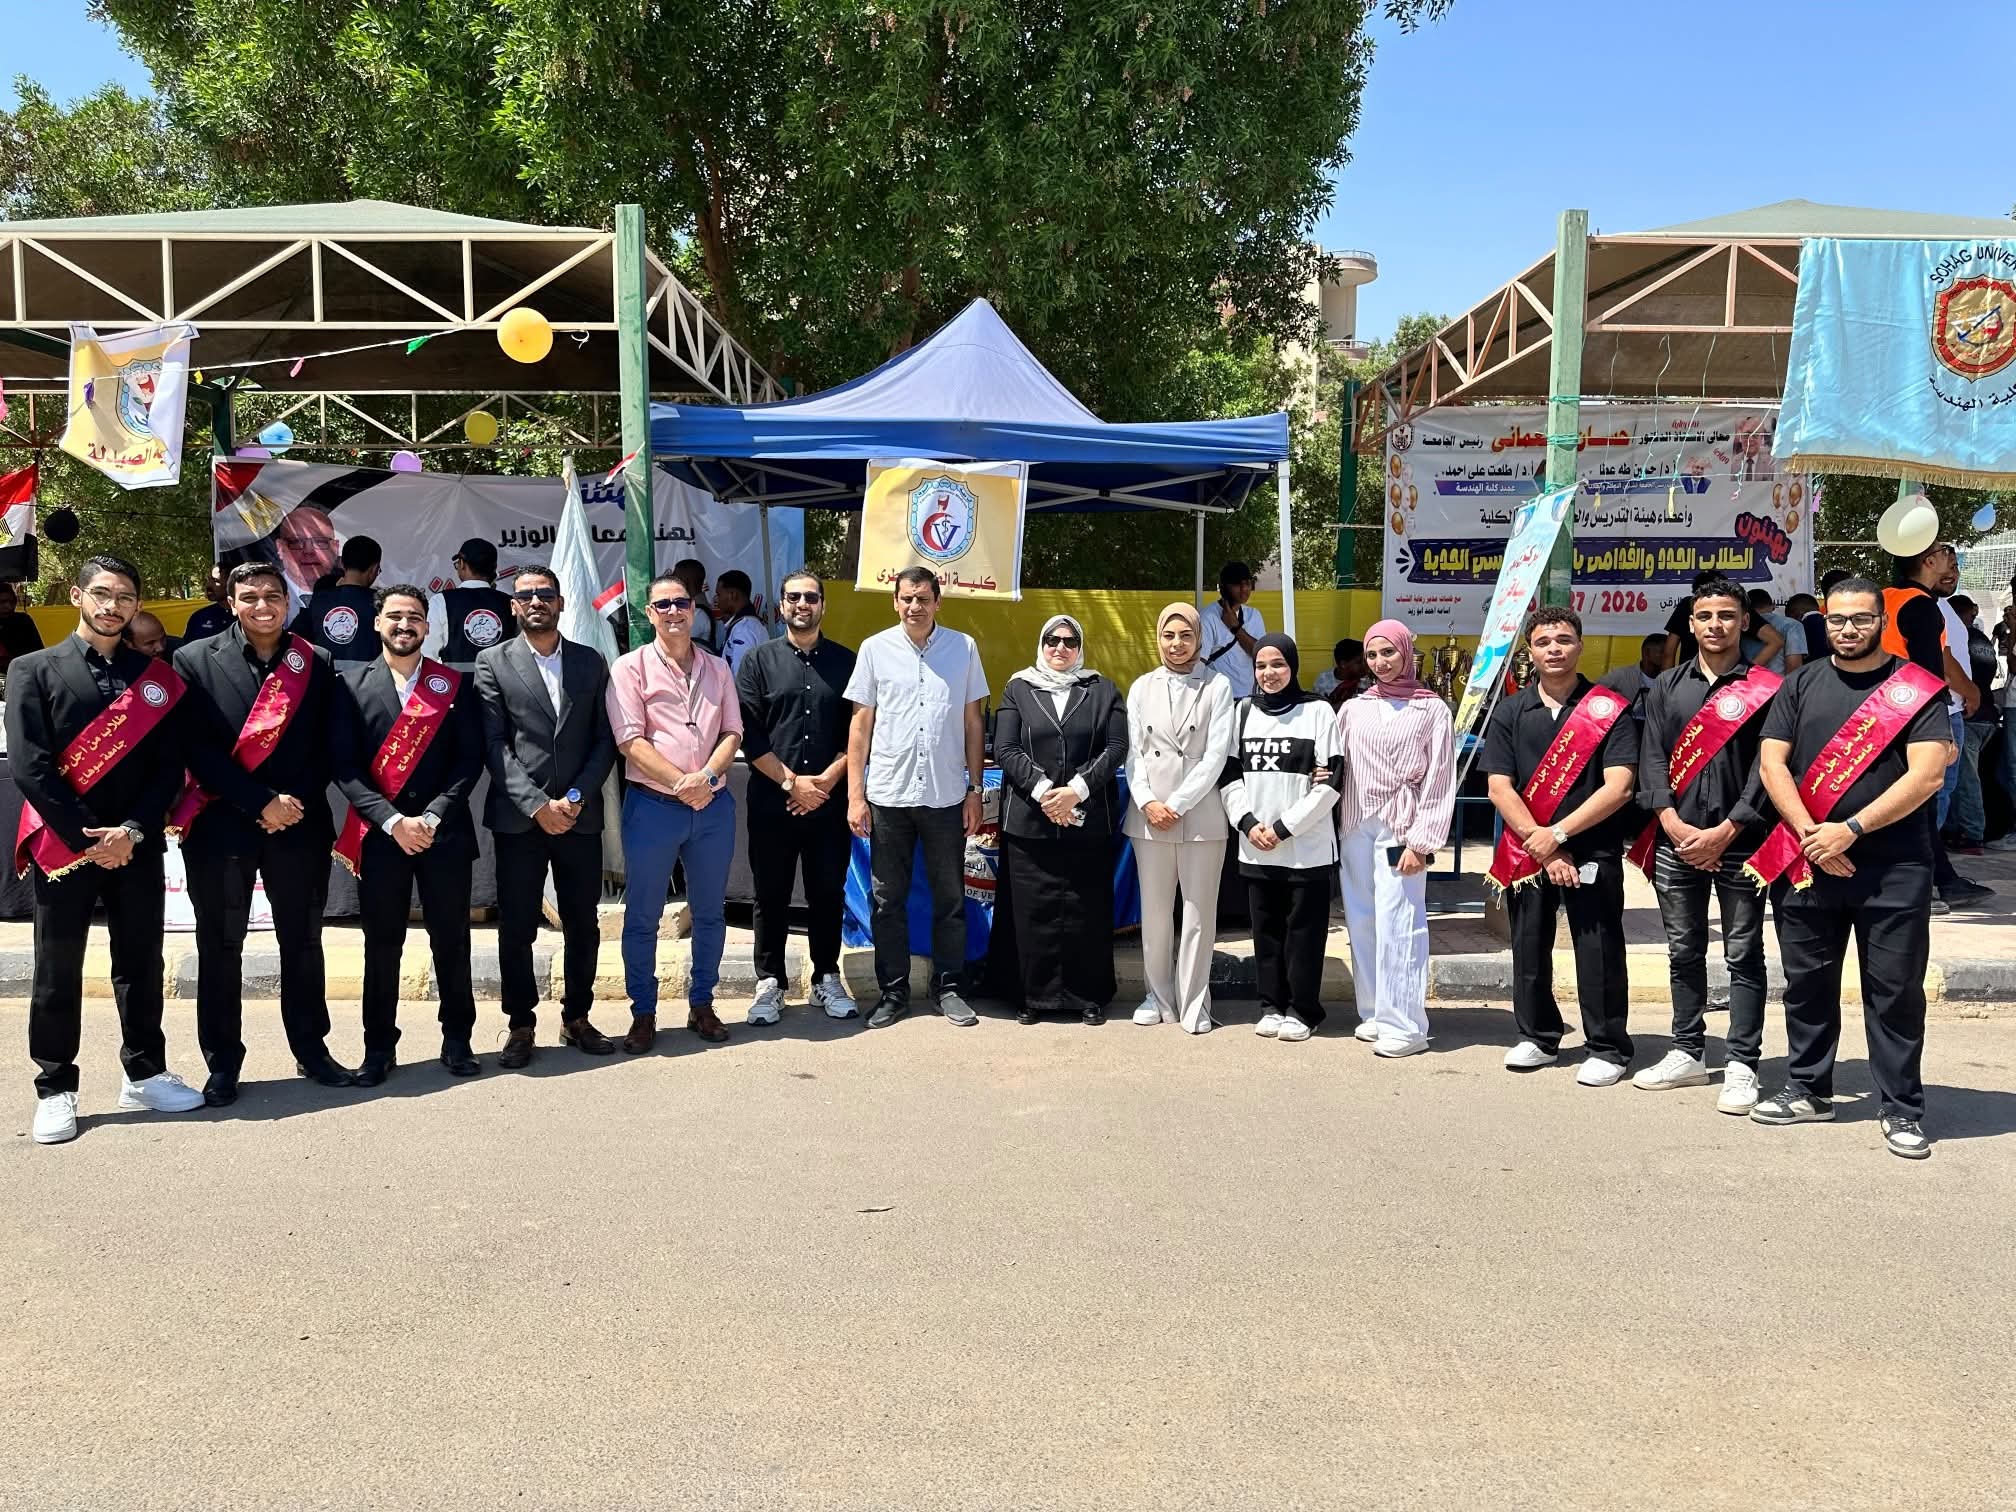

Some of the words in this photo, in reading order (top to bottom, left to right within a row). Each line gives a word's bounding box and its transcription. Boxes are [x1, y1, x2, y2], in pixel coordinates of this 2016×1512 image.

[1929, 249, 1972, 284] SOHAG
[1928, 373, 1983, 411] الهندسة
[1988, 383, 2016, 406] لية
[1422, 434, 1456, 447] الجامعة
[498, 524, 556, 548] الوزير
[1423, 547, 1470, 576] الجديد
[1657, 547, 1696, 575] الجدد
[1699, 547, 1753, 572] الطلاب
[952, 571, 997, 592] كلية
[1601, 590, 1648, 613] 2026
[101, 713, 128, 738] طلاب
[1682, 724, 1704, 747] طلاب
[1853, 716, 1877, 743] طلاب
[87, 735, 102, 751] من
[99, 739, 128, 761] جامعة
[1244, 739, 1292, 754] wht
[1557, 730, 1575, 753] طلاب
[1548, 753, 1559, 766] من
[1560, 751, 1580, 773] جامعة
[1682, 747, 1705, 768] جامعة
[1849, 742, 1876, 766] جامعة
[78, 759, 105, 785] سوهاج
[1670, 767, 1687, 791] سوهاج
[1829, 765, 1855, 792] سوهاج
[1526, 781, 1540, 801] مصر
[1549, 772, 1567, 797] سوهاج
[1810, 772, 1826, 796] مصر
[966, 888, 978, 897] OF
